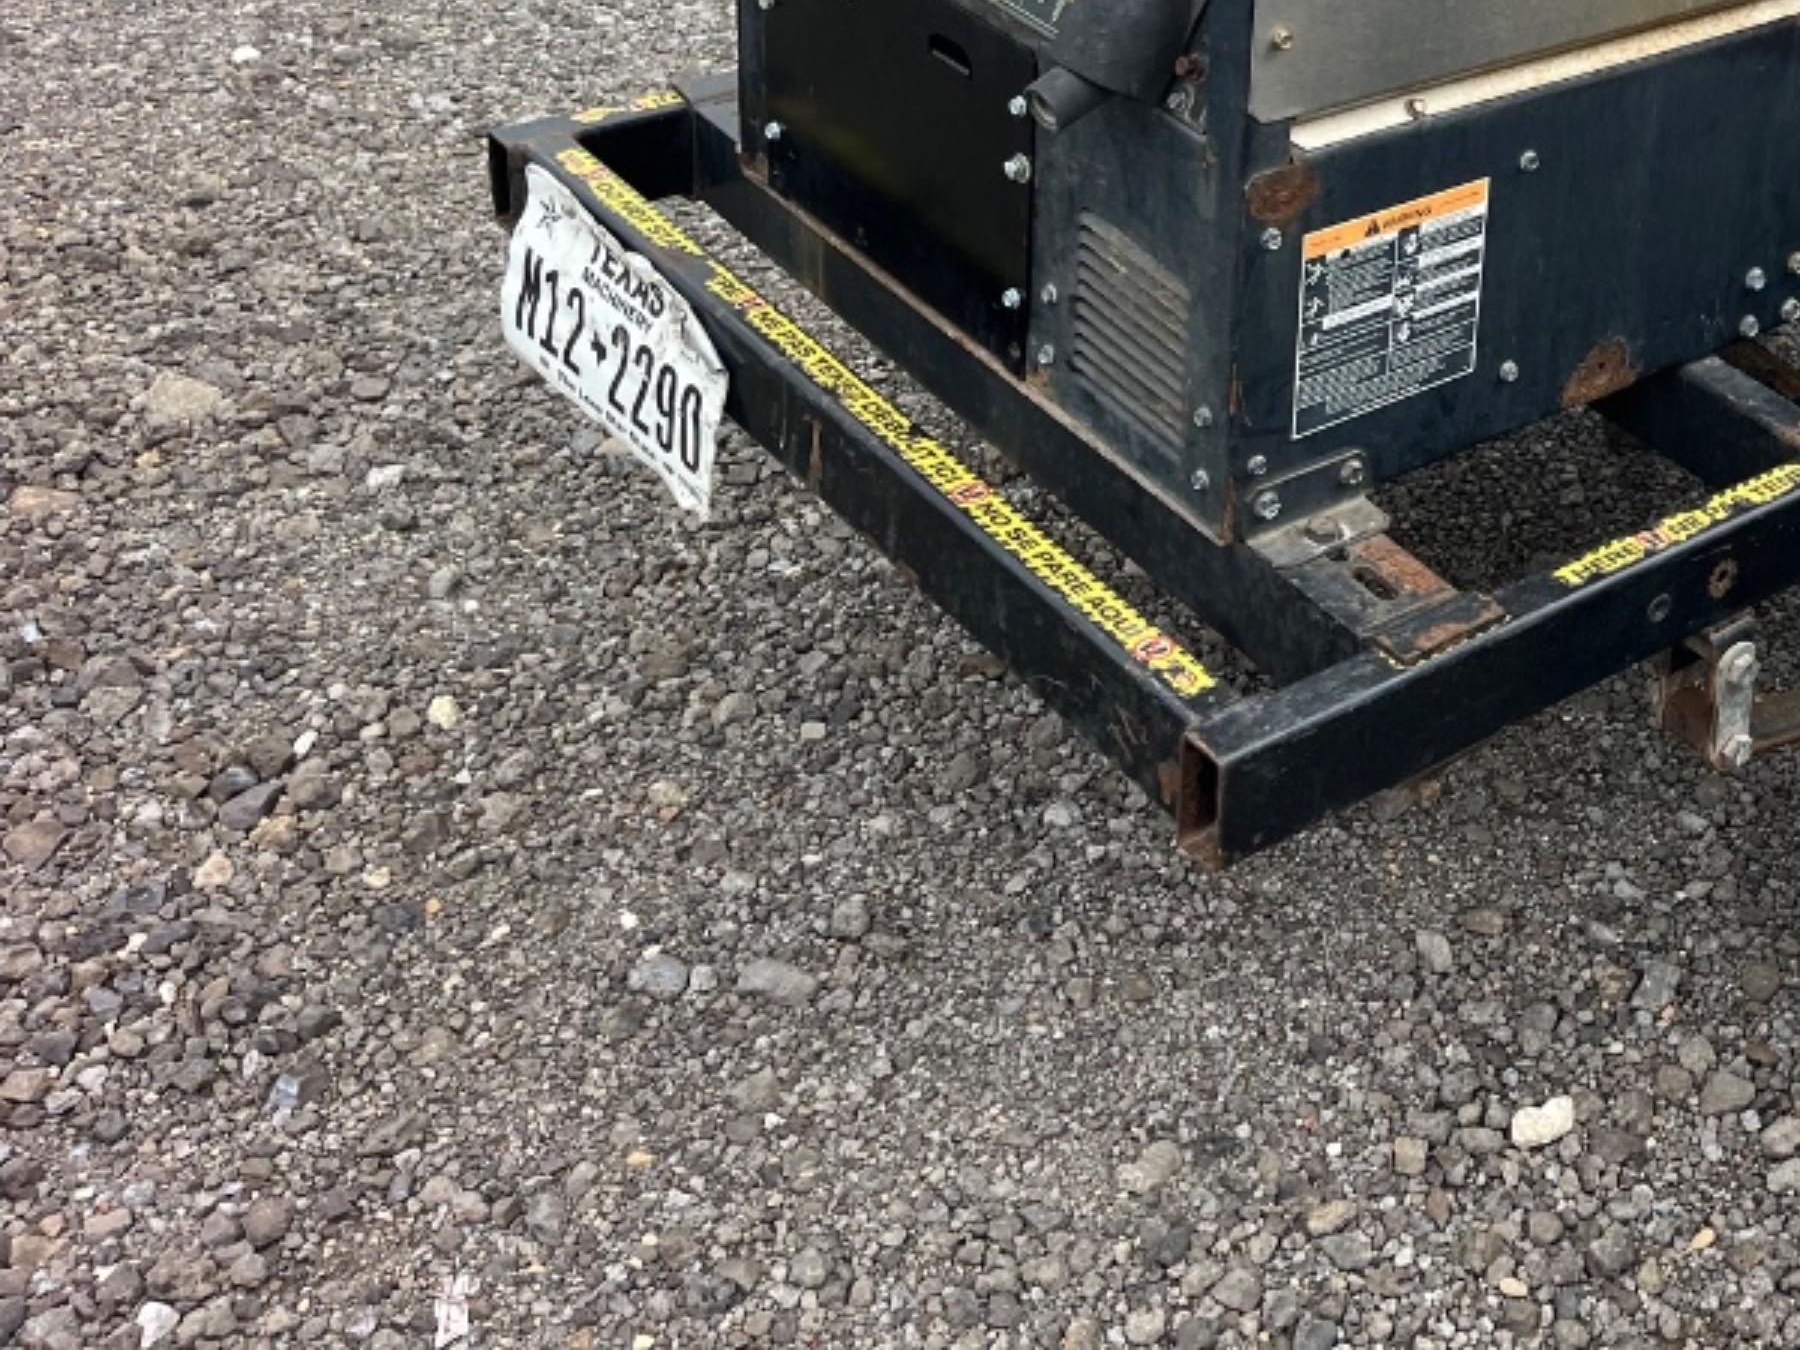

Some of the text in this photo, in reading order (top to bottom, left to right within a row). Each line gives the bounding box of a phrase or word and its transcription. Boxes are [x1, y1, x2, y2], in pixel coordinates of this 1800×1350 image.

[582, 266, 654, 333] MACHINERY
[588, 233, 666, 319] TEXAS
[983, 502, 1012, 527] NO
[1009, 526, 1038, 551] SE
[1034, 550, 1090, 597] PARE
[1091, 595, 1144, 638] AQUI
